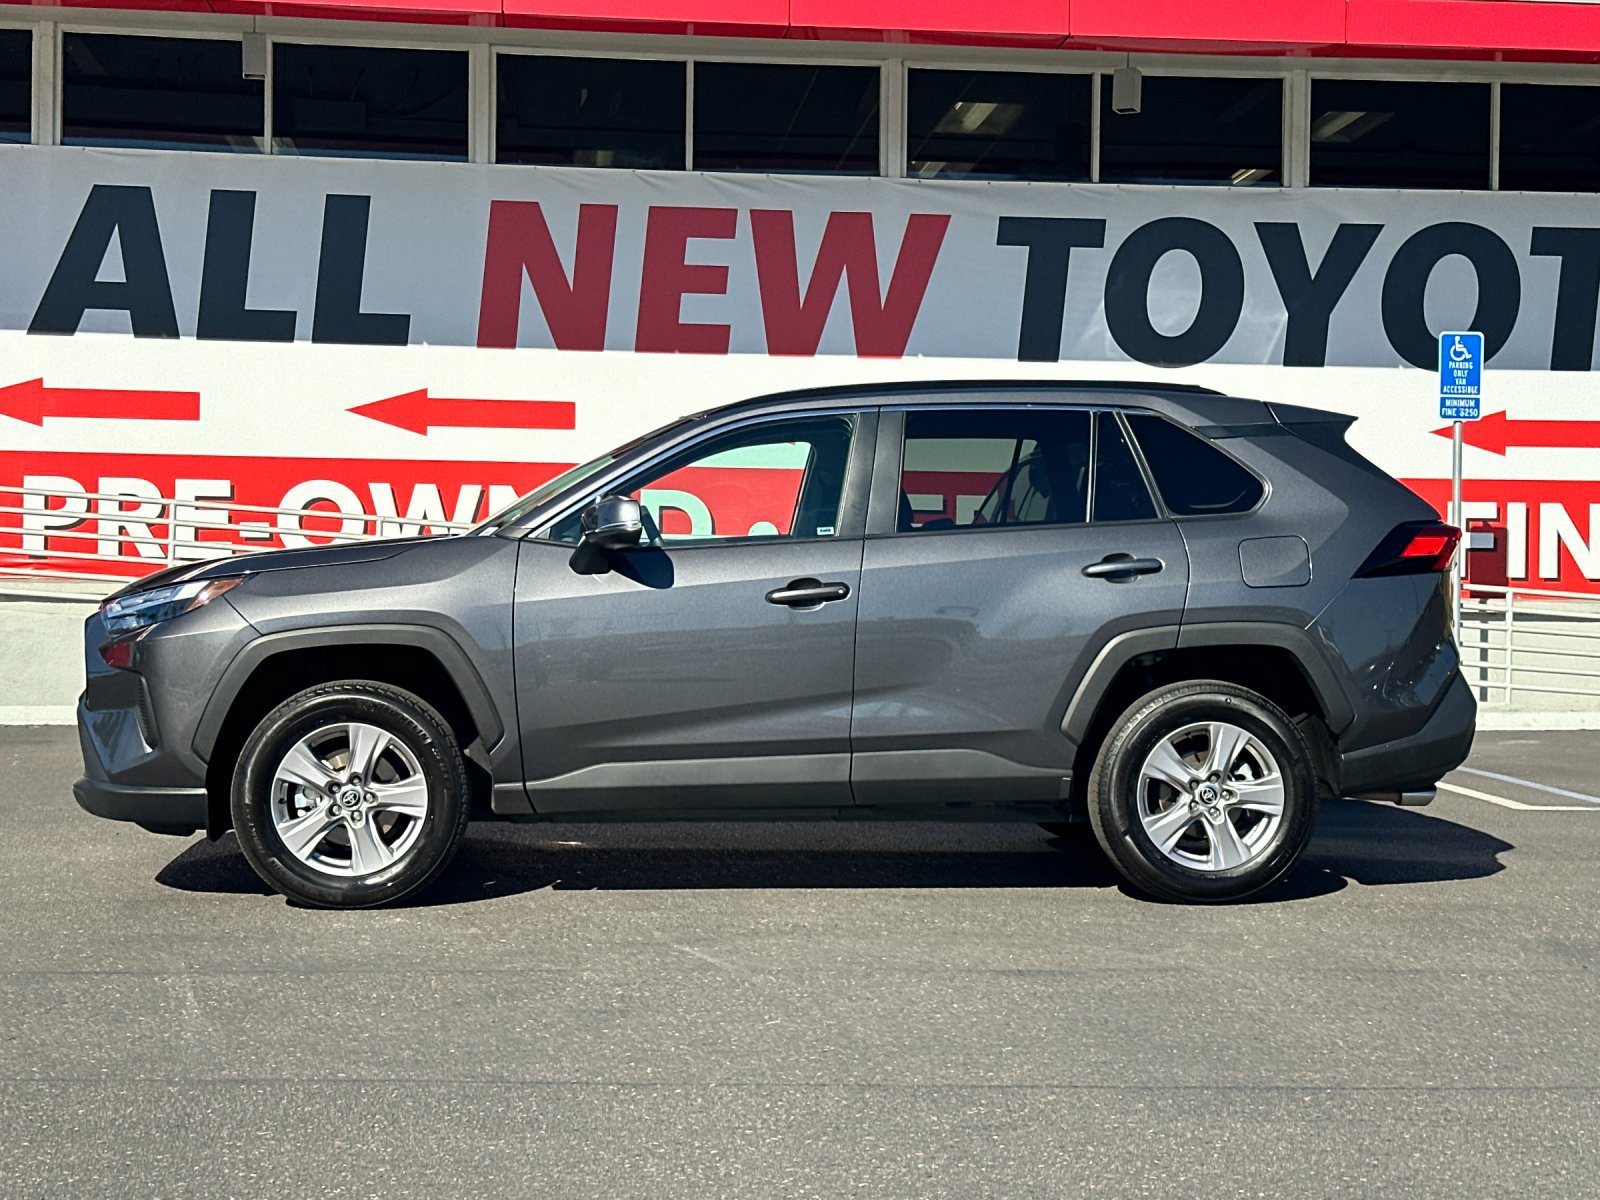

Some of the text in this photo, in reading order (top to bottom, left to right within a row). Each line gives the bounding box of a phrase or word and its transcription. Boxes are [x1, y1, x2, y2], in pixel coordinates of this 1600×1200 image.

[26, 184, 1600, 371] ALL NEW TOYOT
[1448, 361, 1473, 369] PARKING
[1445, 399, 1475, 407] MINIMUM
[1441, 408, 1478, 417] FINE $250
